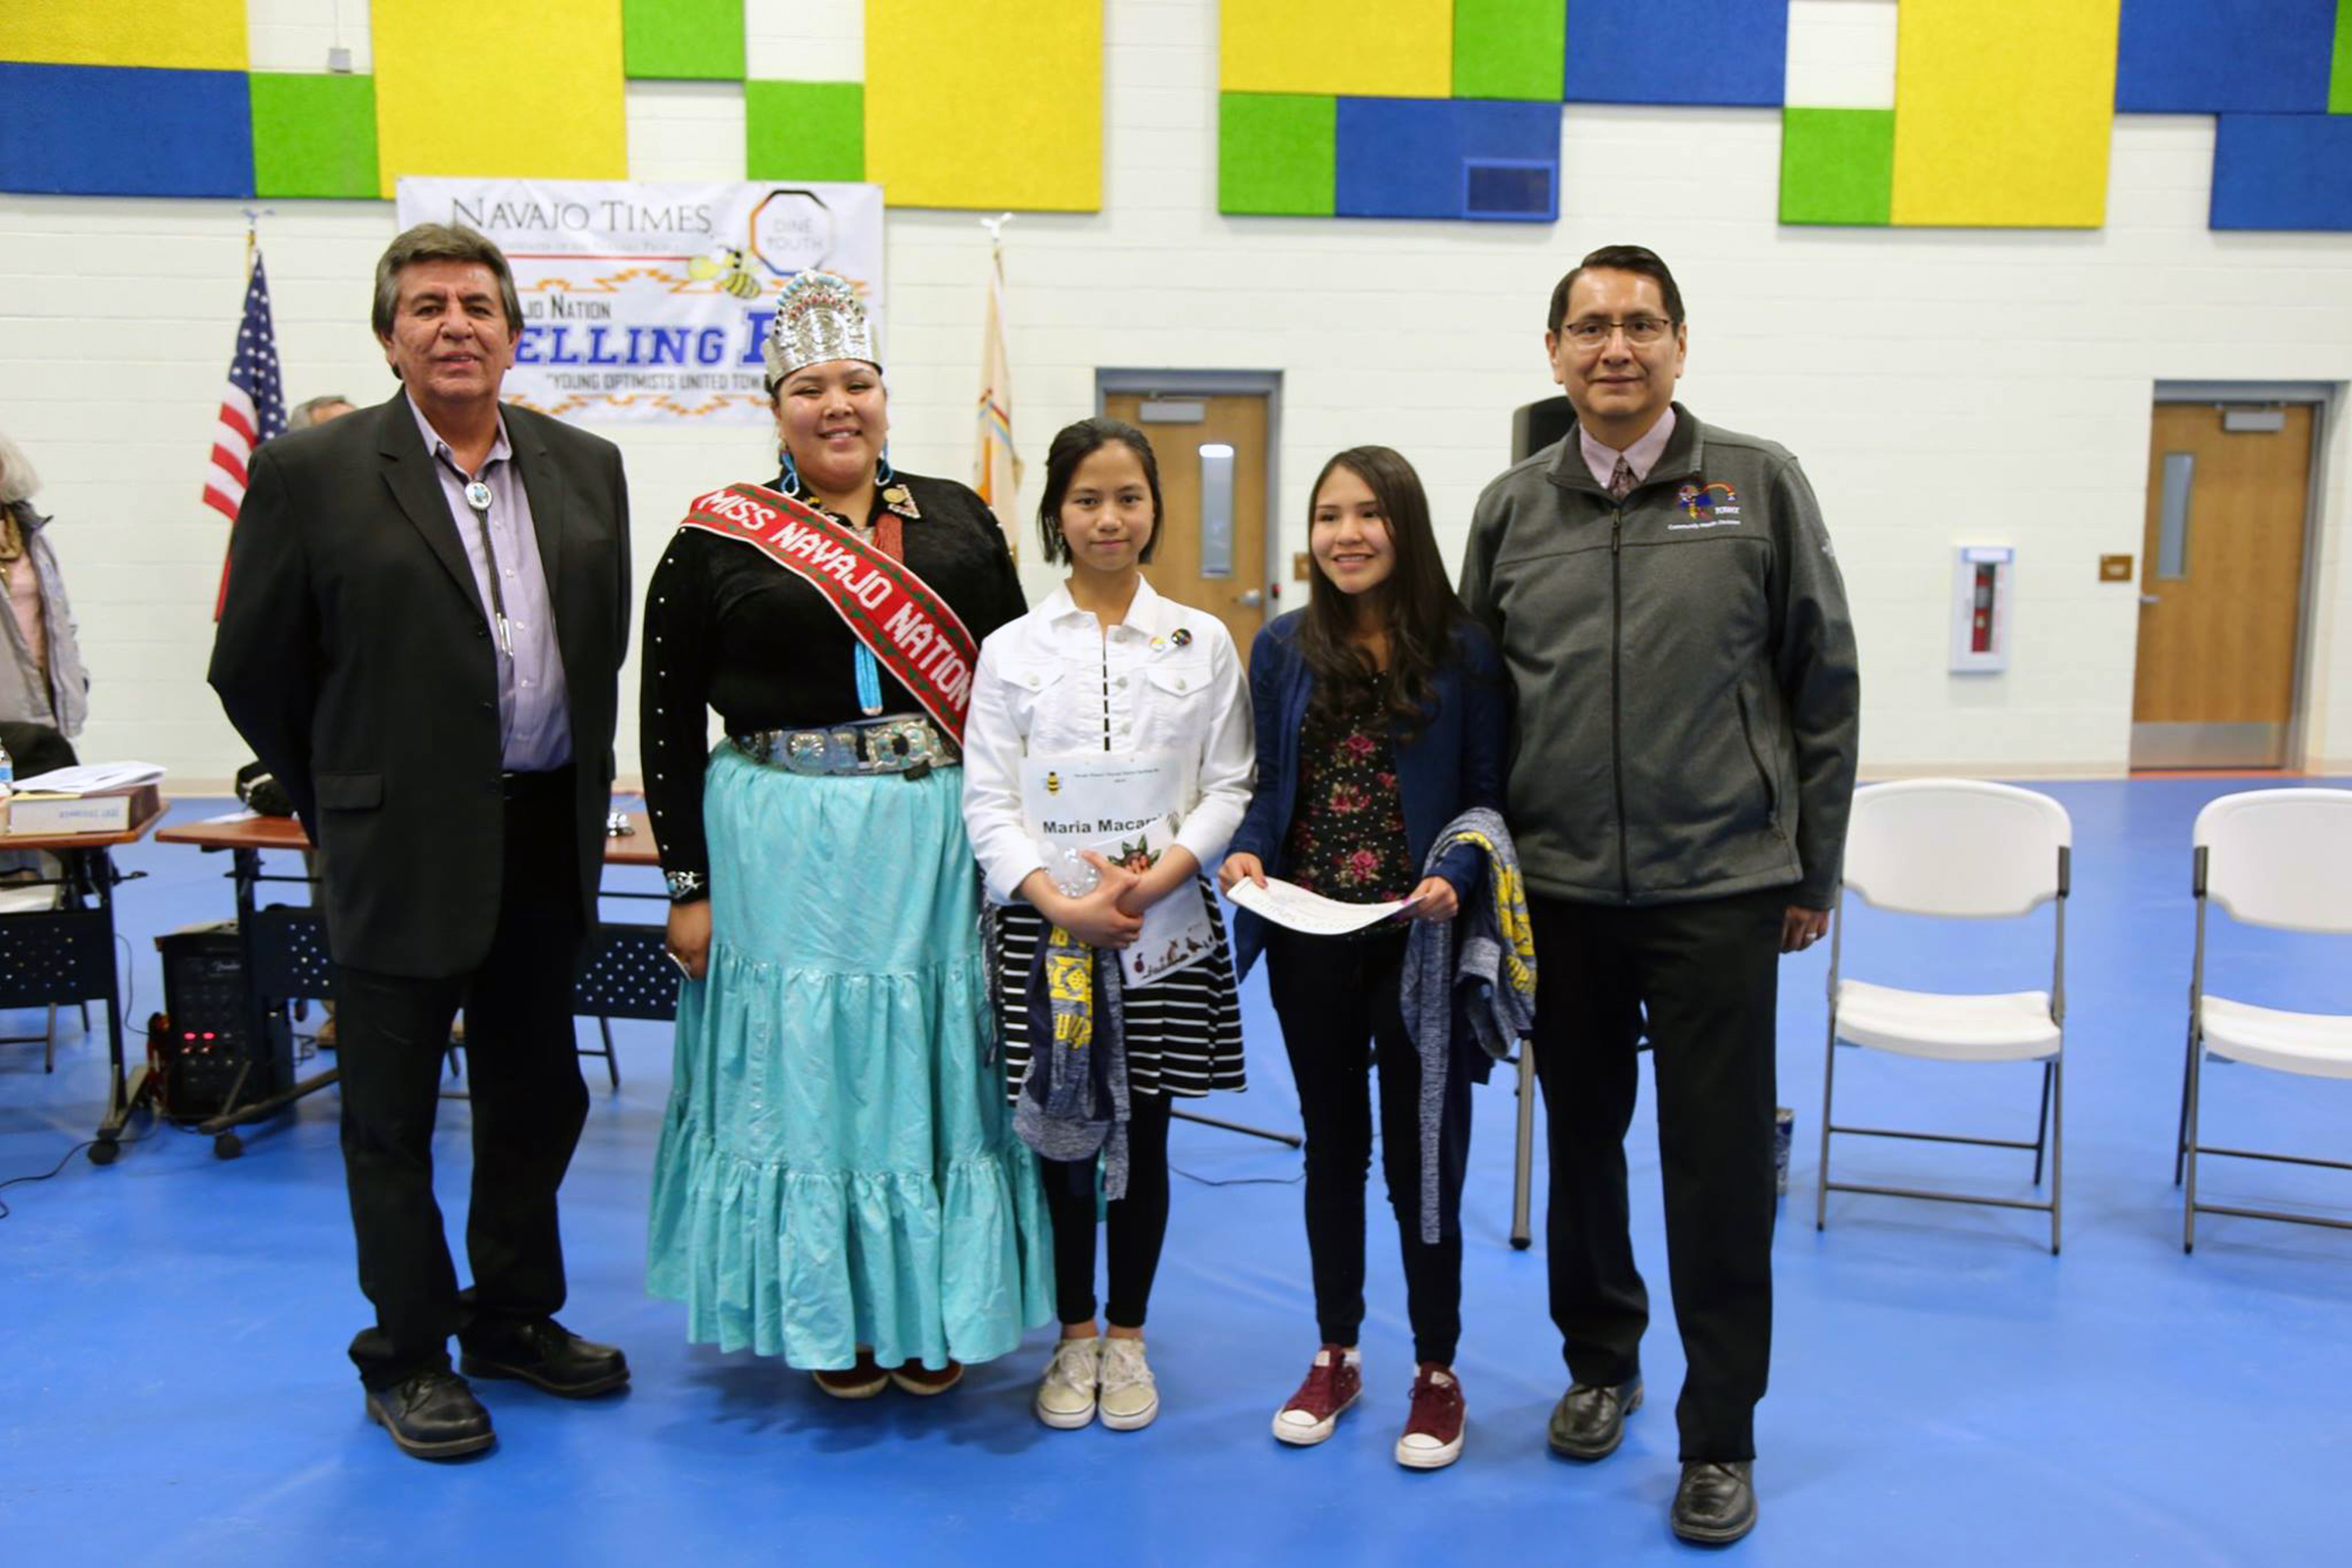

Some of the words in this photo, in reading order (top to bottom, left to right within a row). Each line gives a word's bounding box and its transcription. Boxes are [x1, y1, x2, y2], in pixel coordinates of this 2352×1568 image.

[453, 198, 589, 230] NAVAJO
[601, 200, 712, 234] TIMES
[551, 294, 612, 319] NATION
[514, 326, 724, 364] ELLING
[680, 372, 728, 390] UNITED
[697, 489, 776, 530] MISS
[768, 521, 894, 611] NAVAJO
[883, 600, 973, 712] NATION
[1043, 819, 1092, 834] Maria
[1098, 813, 1162, 832] Macar
